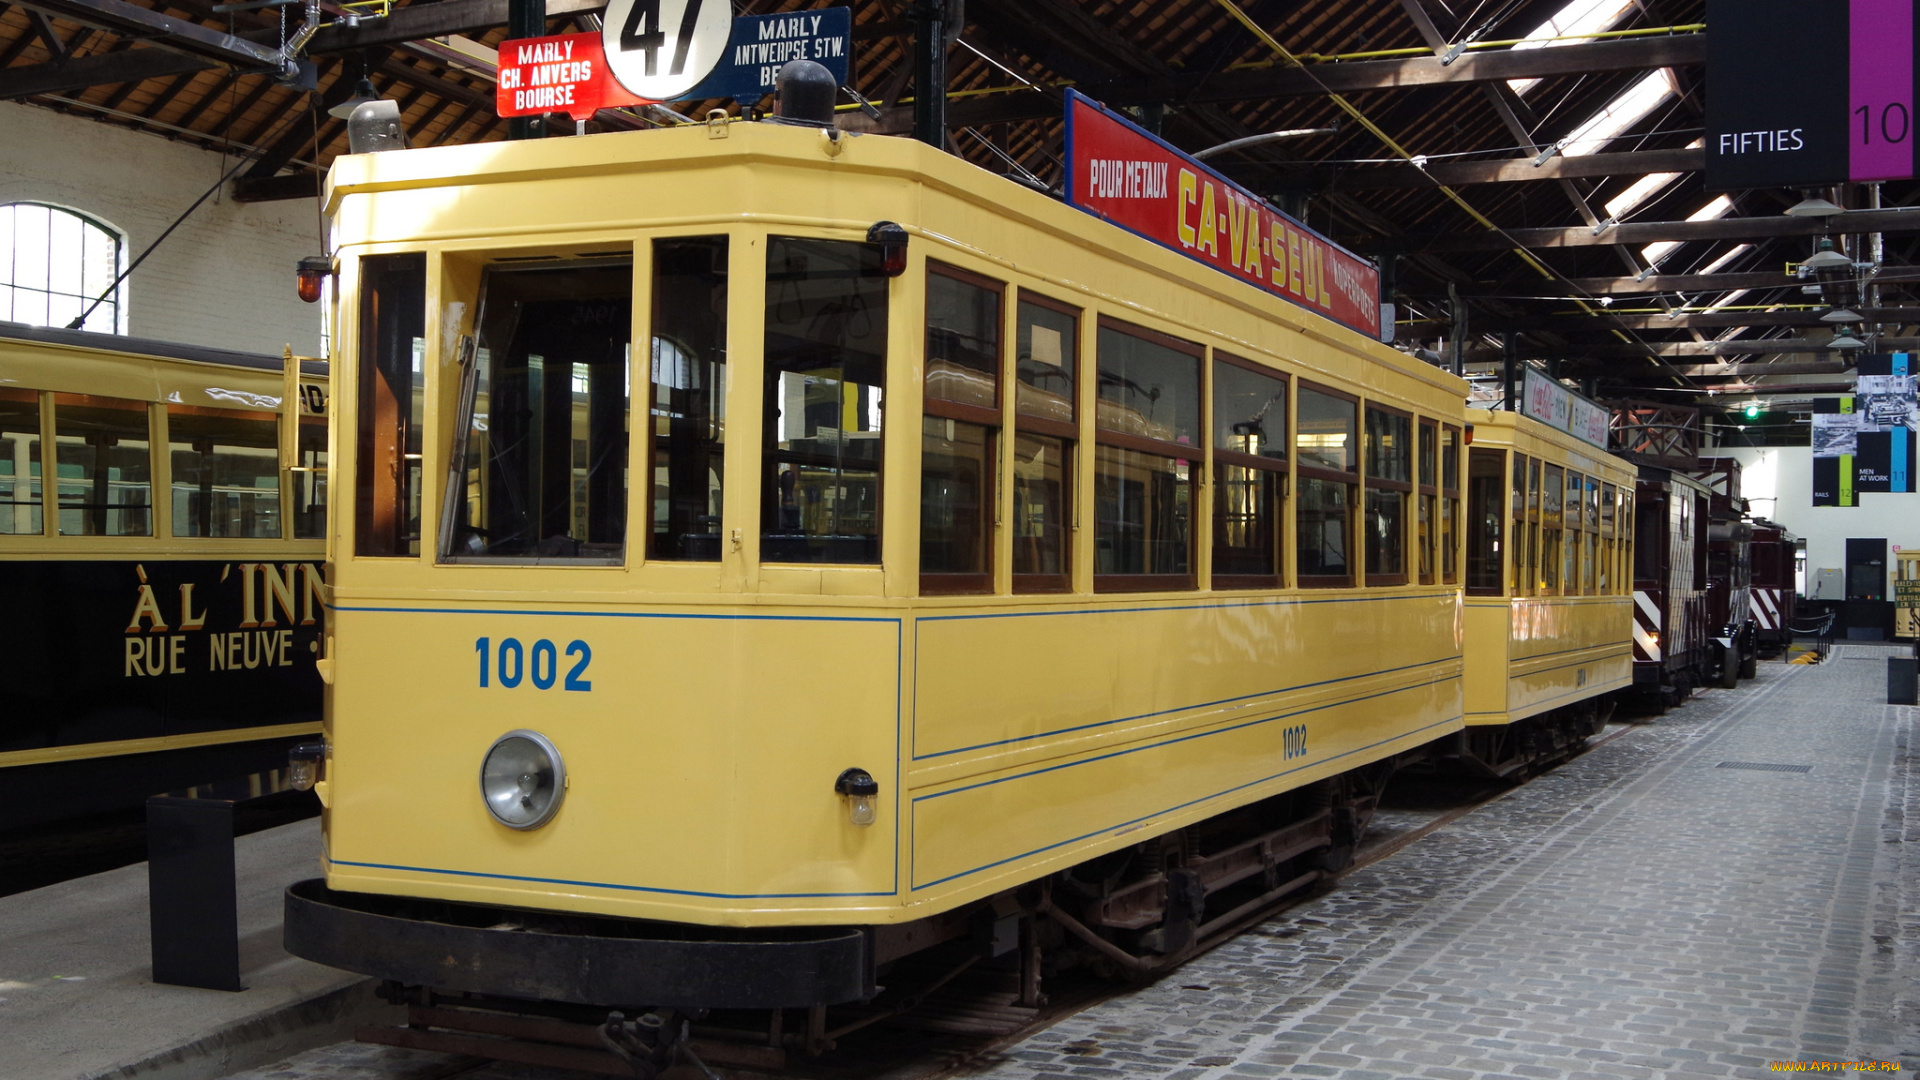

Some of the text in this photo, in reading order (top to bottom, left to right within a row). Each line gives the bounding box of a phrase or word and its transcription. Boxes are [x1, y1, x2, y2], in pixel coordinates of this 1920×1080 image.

[620, 0, 703, 77] 47
[758, 15, 822, 41] MARLY
[517, 40, 574, 65] MARLY
[734, 36, 844, 66] ANTWERPSE STW.
[500, 60, 592, 90] CH. ANVERS
[760, 65, 780, 87] BE
[514, 85, 575, 110] BOURSE
[1719, 102, 1909, 155] FIFTIES 10
[1090, 158, 1169, 200] POUR METAUX
[1892, 470, 1906, 482] 11
[1840, 488, 1852, 498] 12
[125, 563, 169, 634] À
[125, 629, 294, 678] RUE NEUVE
[475, 636, 593, 692] 1002
[1283, 724, 1306, 761] 1002
